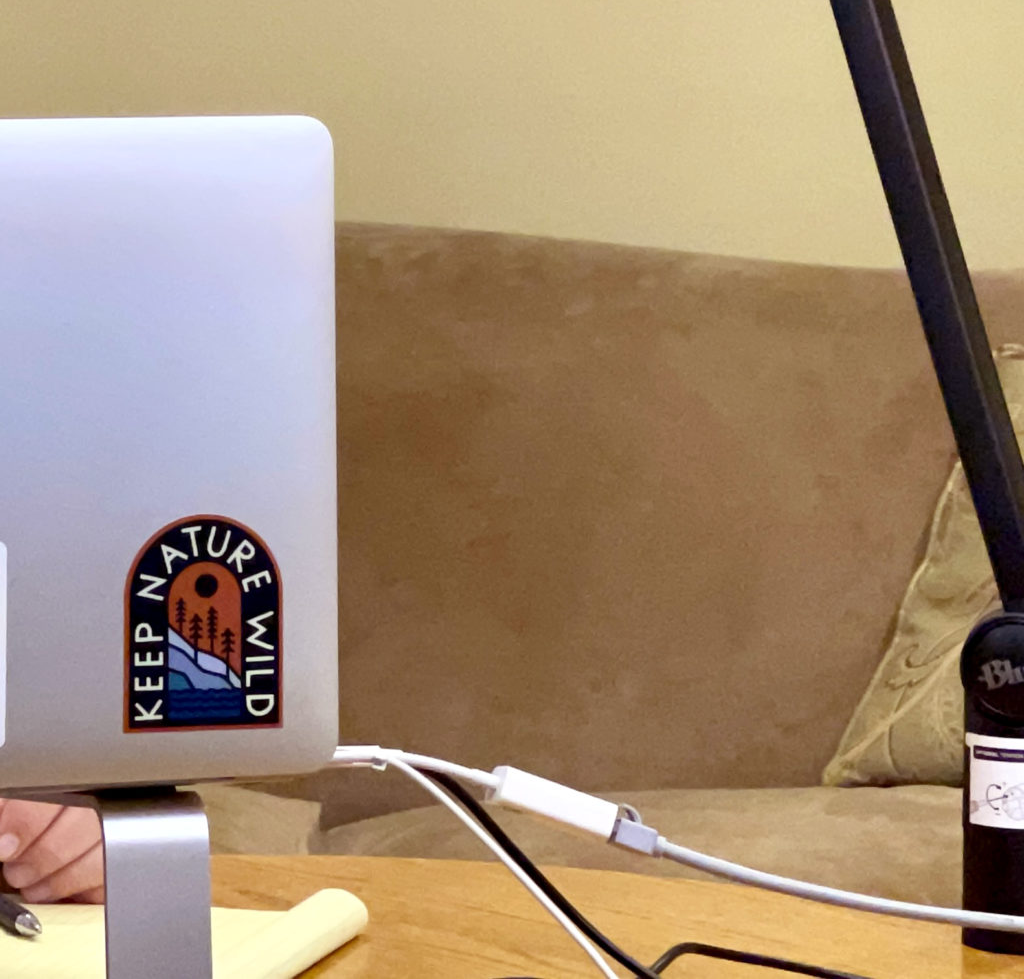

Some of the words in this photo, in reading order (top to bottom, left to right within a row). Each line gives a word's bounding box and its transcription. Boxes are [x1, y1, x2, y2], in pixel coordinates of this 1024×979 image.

[136, 525, 272, 601] NATURE
[134, 622, 164, 722] KEEP
[245, 610, 275, 717] WILD
